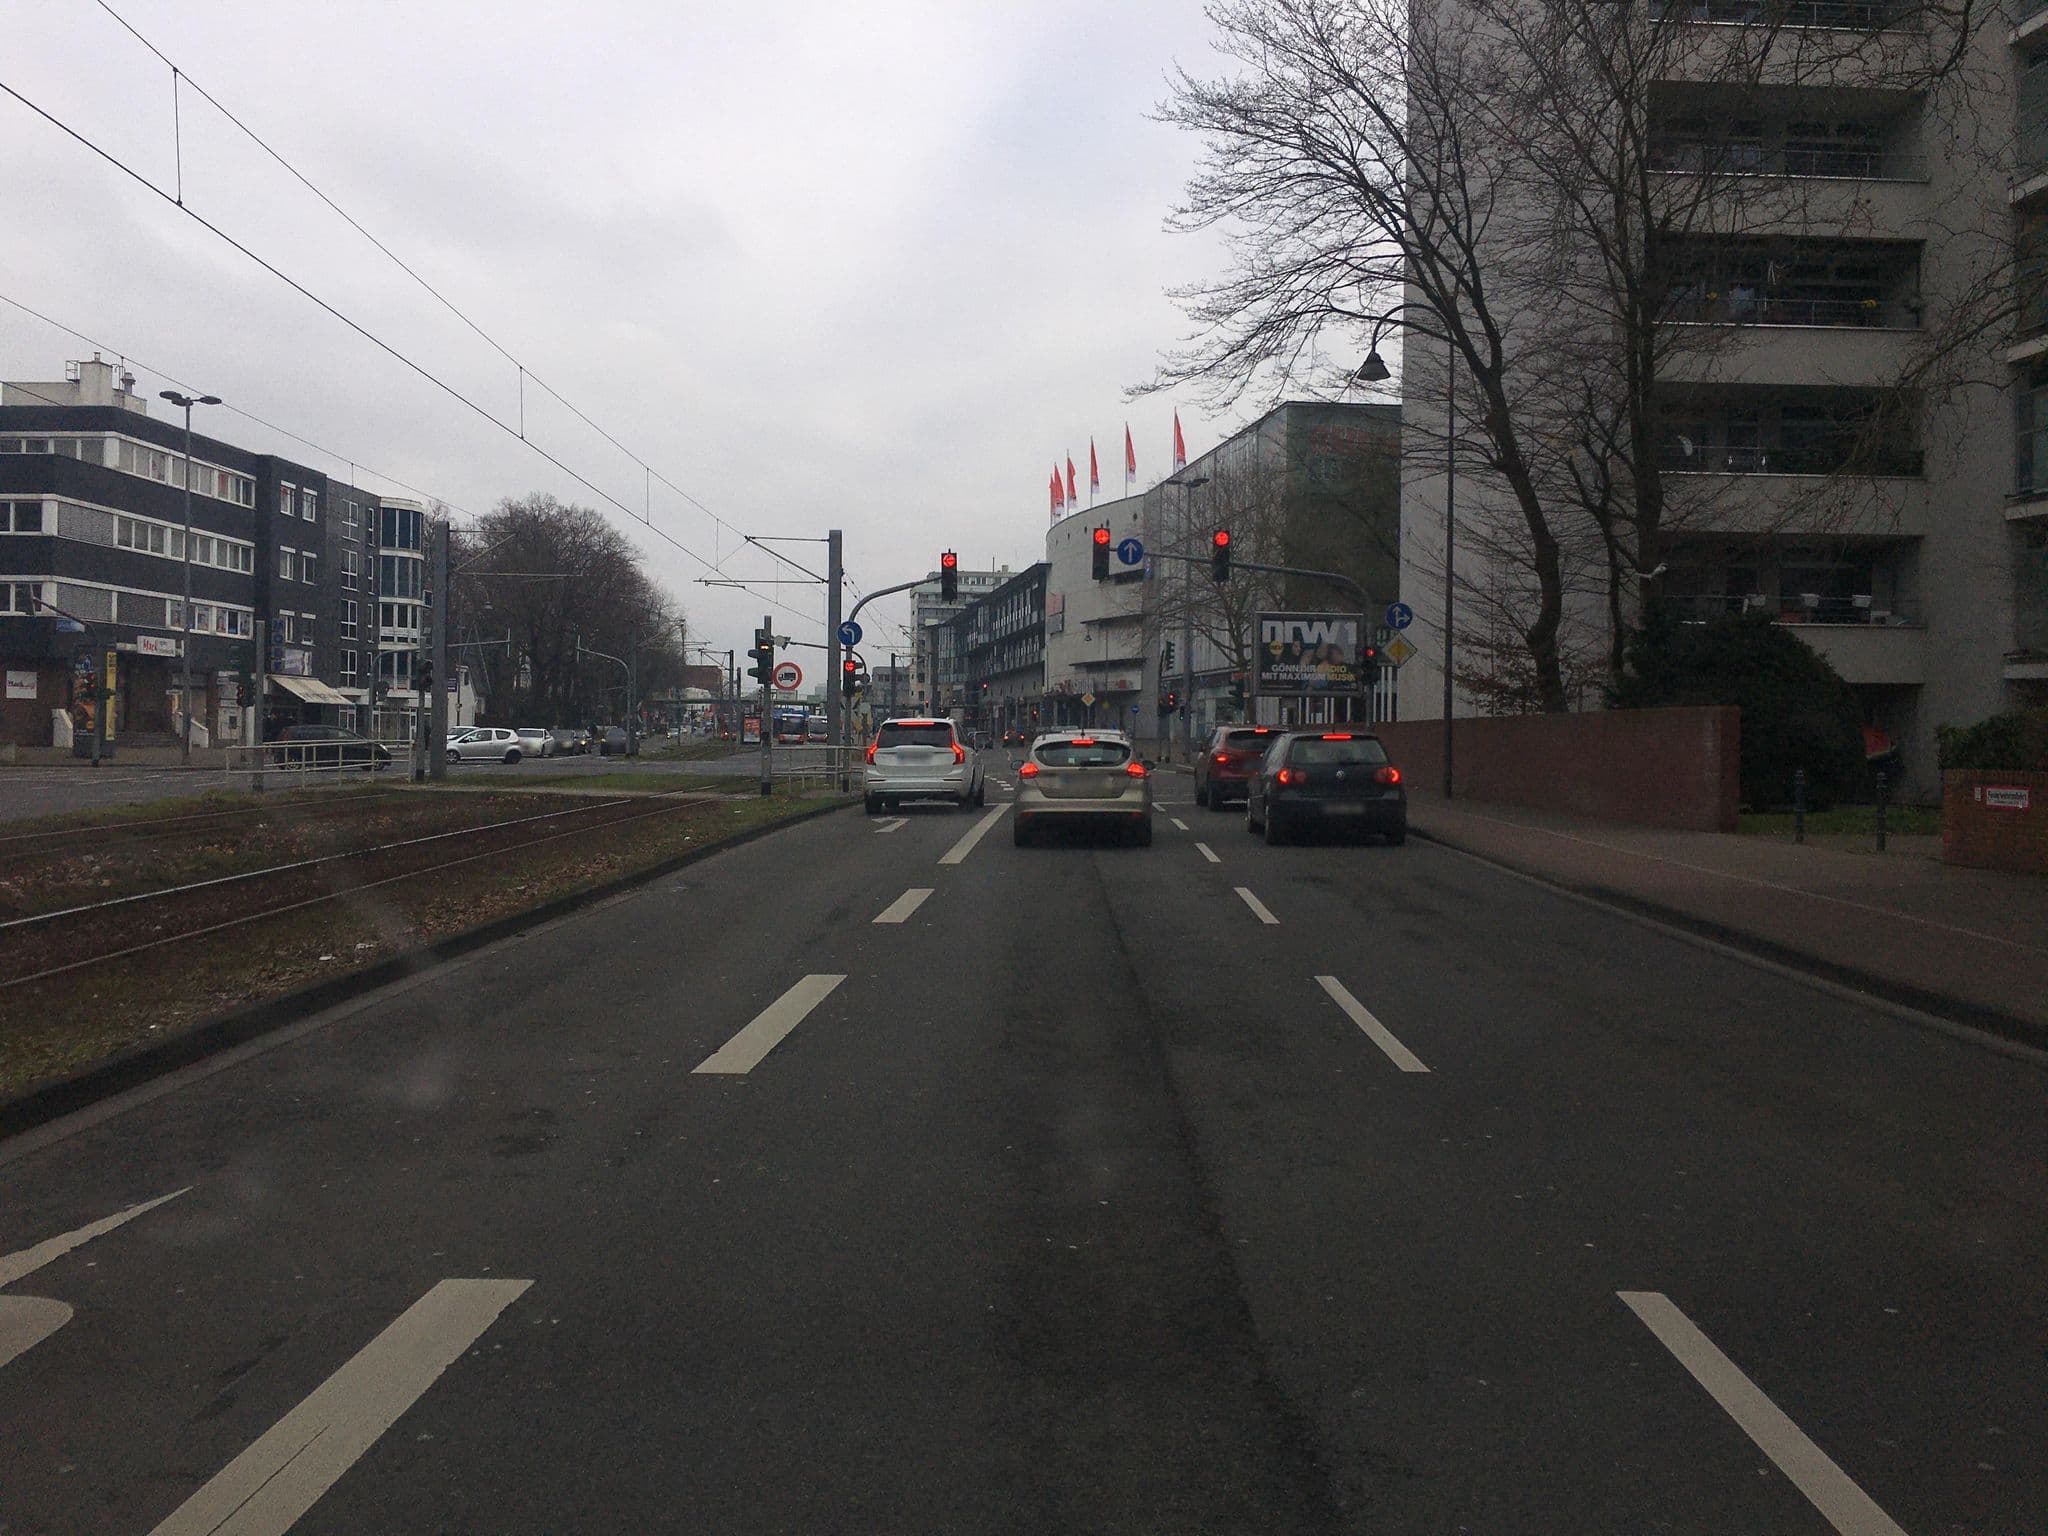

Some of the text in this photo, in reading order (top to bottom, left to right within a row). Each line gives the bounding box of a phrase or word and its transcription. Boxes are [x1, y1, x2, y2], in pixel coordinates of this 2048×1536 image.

[1271, 663, 1299, 672] GÖNN
[1300, 664, 1316, 672] DIR
[1261, 672, 1278, 680] MIT
